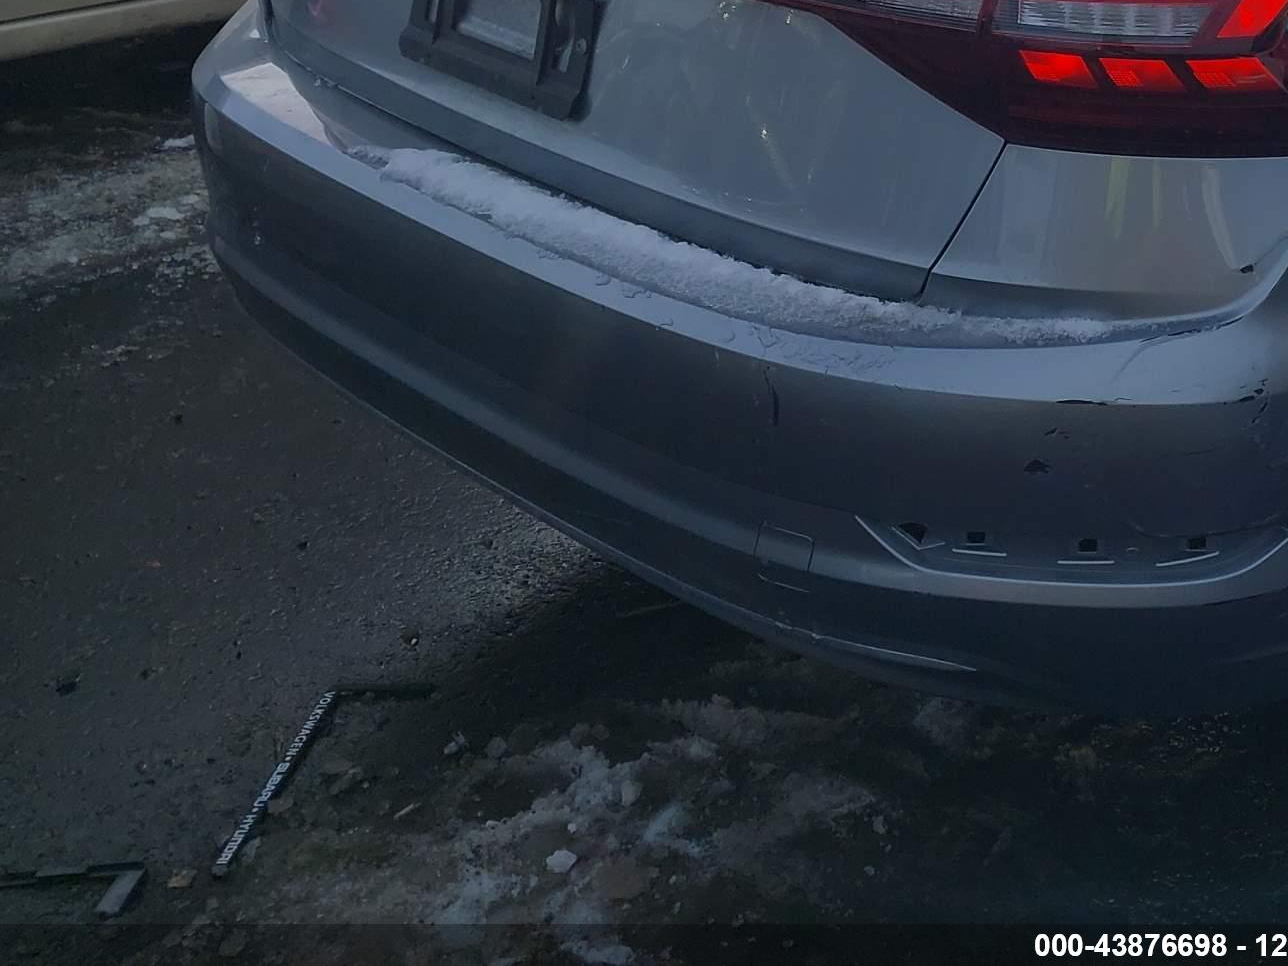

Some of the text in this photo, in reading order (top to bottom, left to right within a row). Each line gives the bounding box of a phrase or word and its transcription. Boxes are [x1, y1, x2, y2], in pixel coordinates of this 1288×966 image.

[216, 691, 336, 865] VOLKSWAGEN SUBARU HYUNDAI
